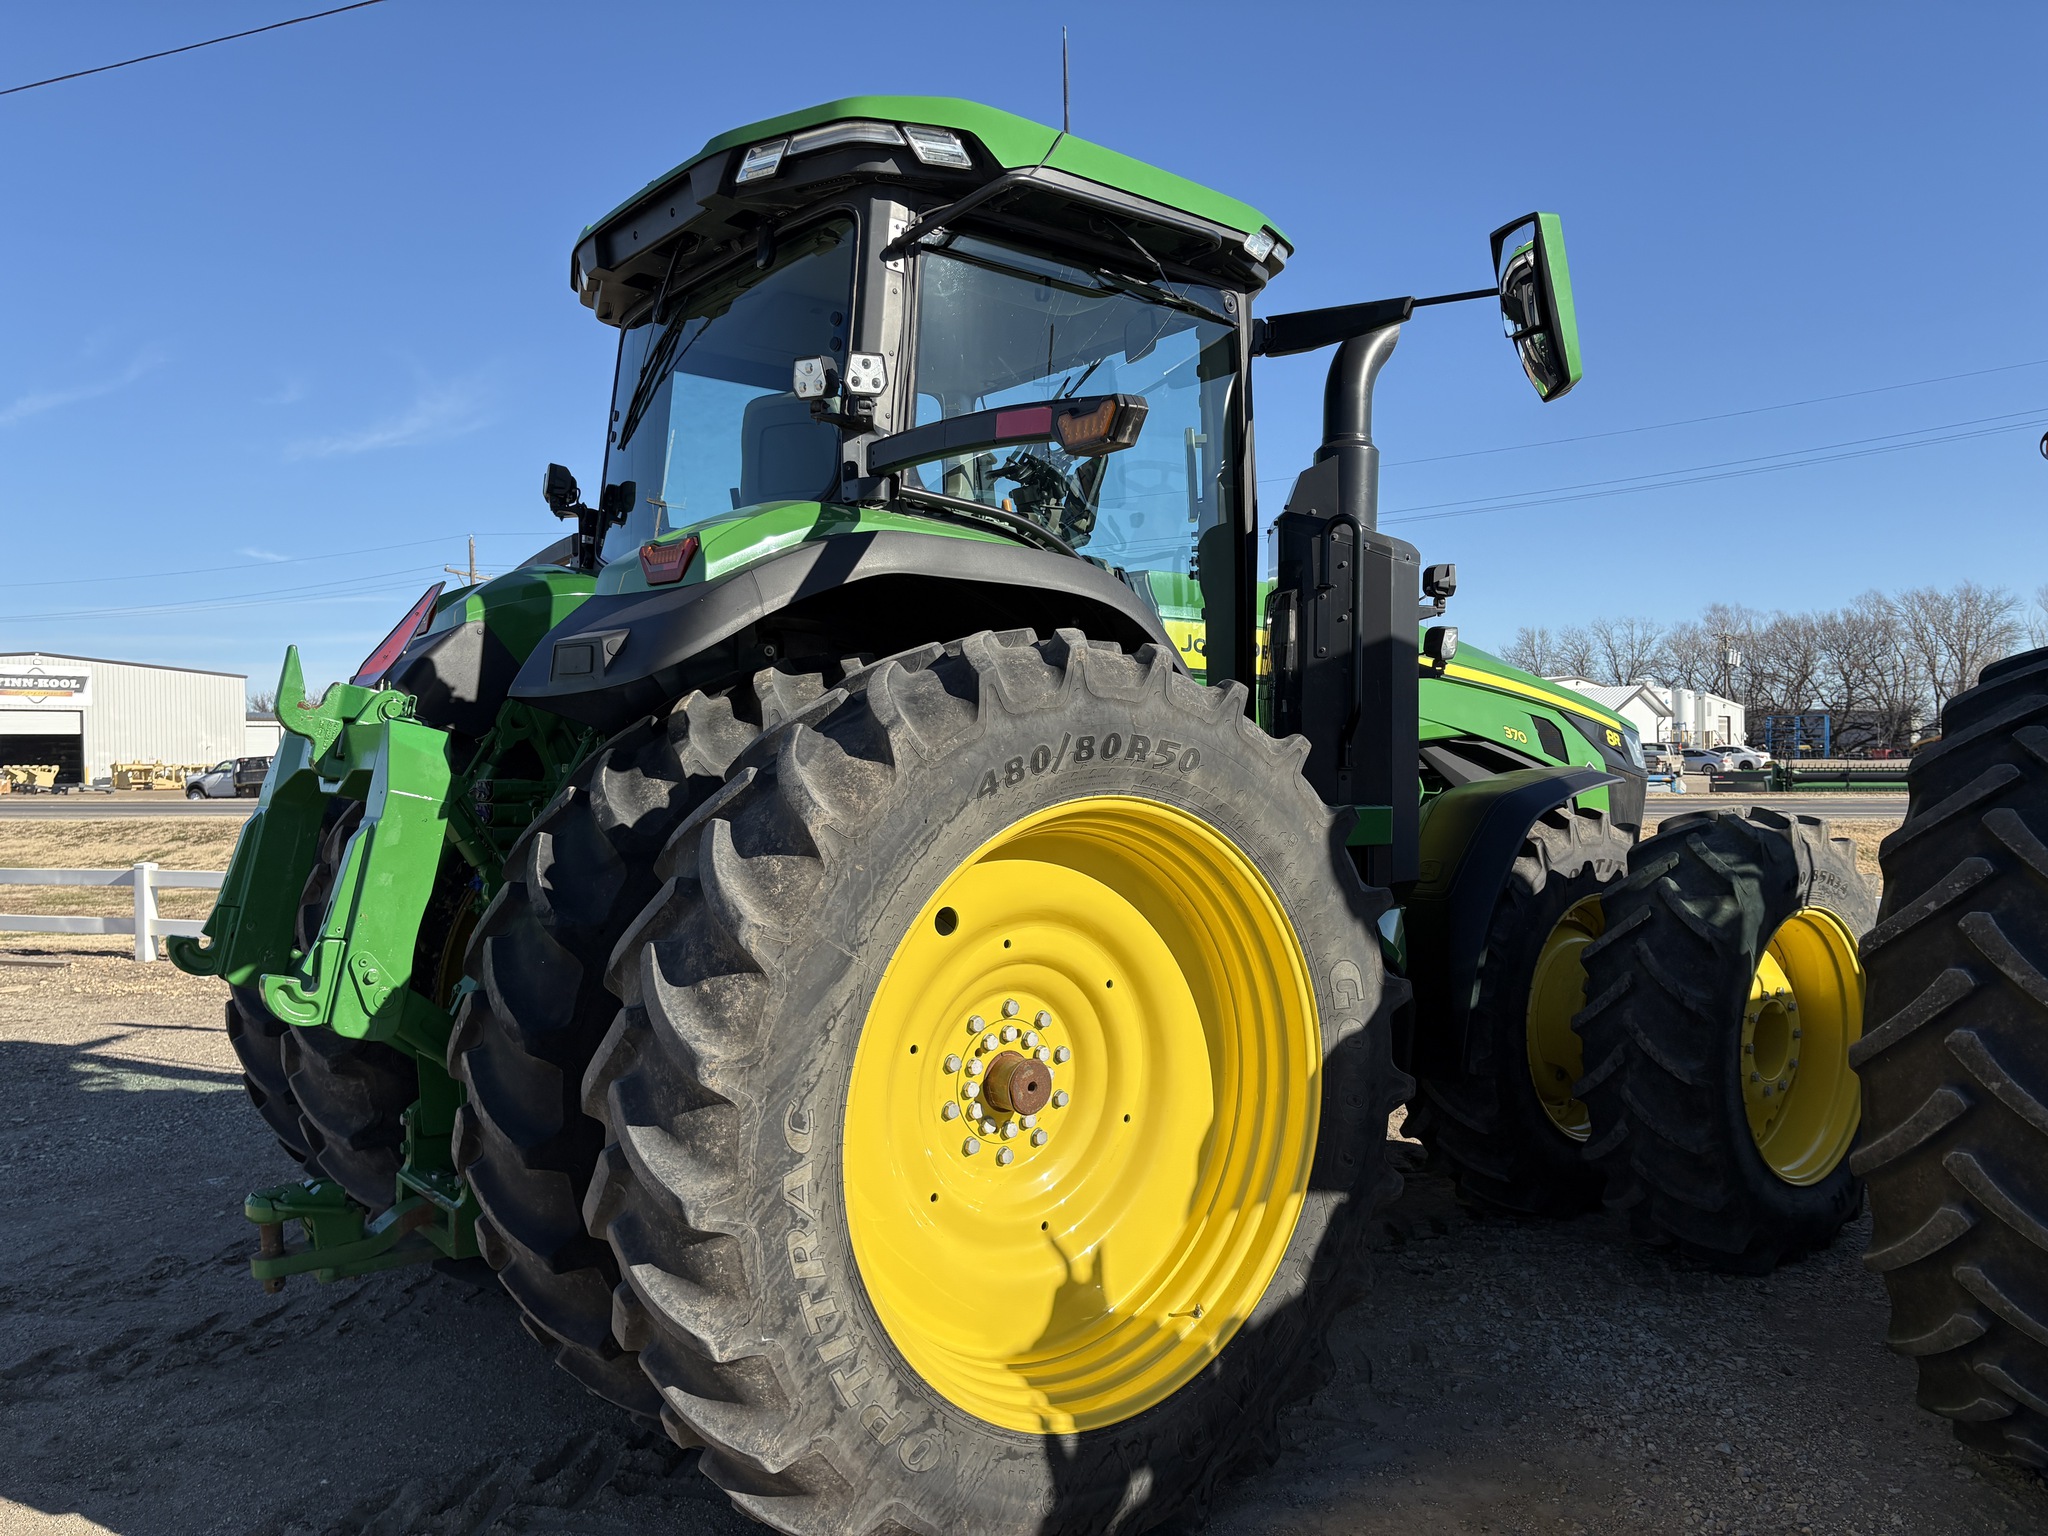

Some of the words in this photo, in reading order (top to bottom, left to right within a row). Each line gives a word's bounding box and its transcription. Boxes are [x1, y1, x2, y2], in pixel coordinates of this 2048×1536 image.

[0, 677, 80, 689] INN-KOOL
[1503, 725, 1528, 744] 370
[1605, 729, 1621, 747] 8R
[976, 731, 1202, 801] 480/80R50
[781, 1099, 942, 1474] OPTITRAC
